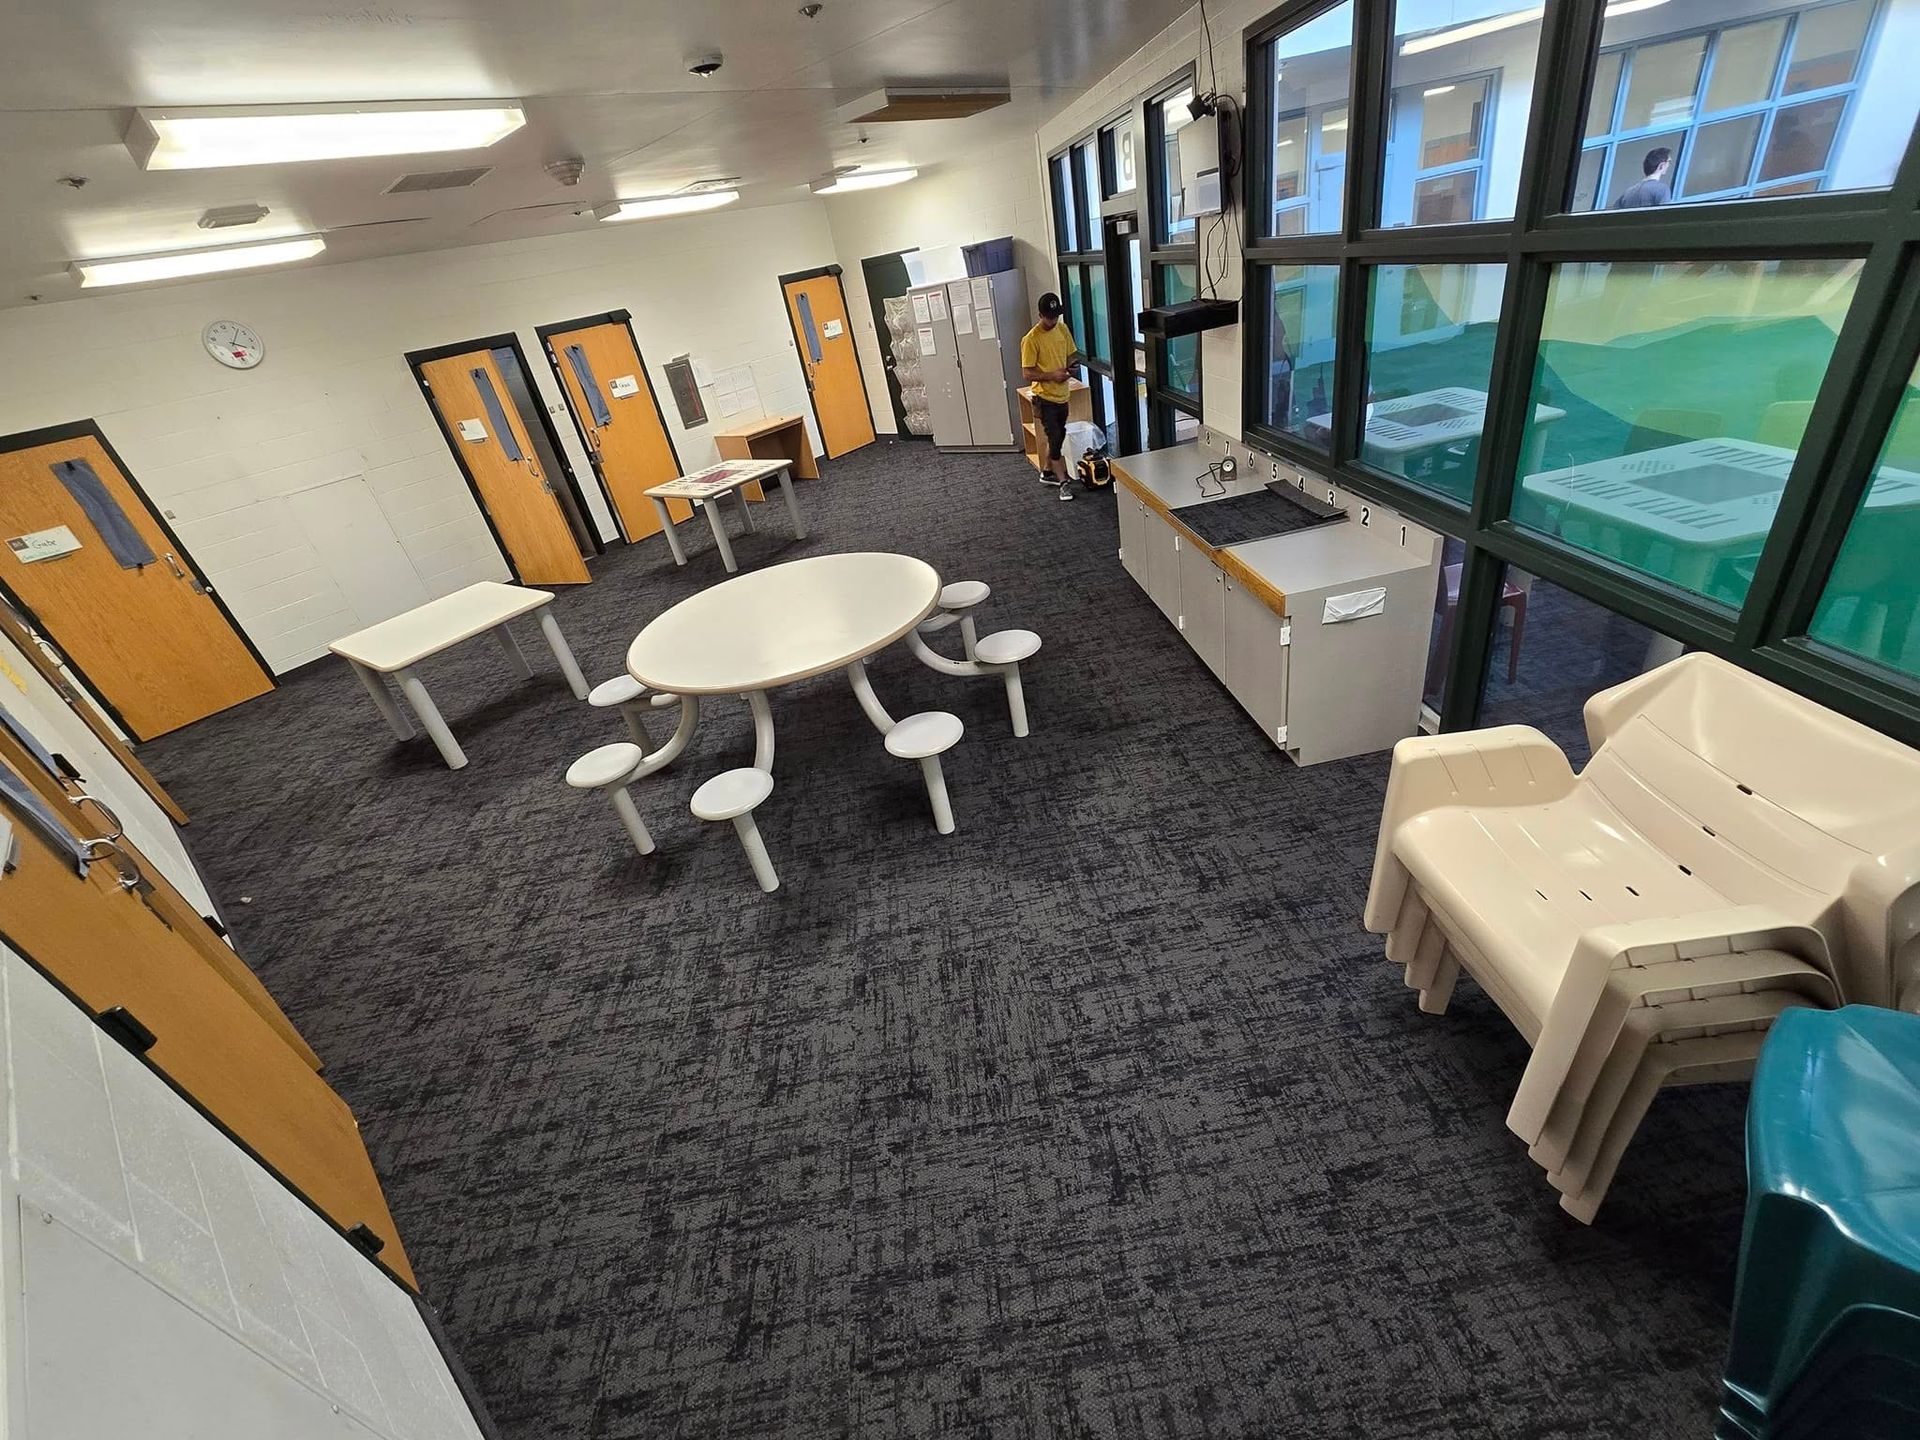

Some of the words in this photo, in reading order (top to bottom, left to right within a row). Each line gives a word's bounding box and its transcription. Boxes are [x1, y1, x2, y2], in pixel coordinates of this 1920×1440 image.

[1225, 440, 1230, 455] 7
[1248, 452, 1254, 467] 6
[1271, 463, 1277, 479] 5
[1298, 477, 1304, 492] 4
[1327, 490, 1335, 507] 3
[1361, 506, 1370, 527] 2
[1401, 526, 1406, 546] 1
